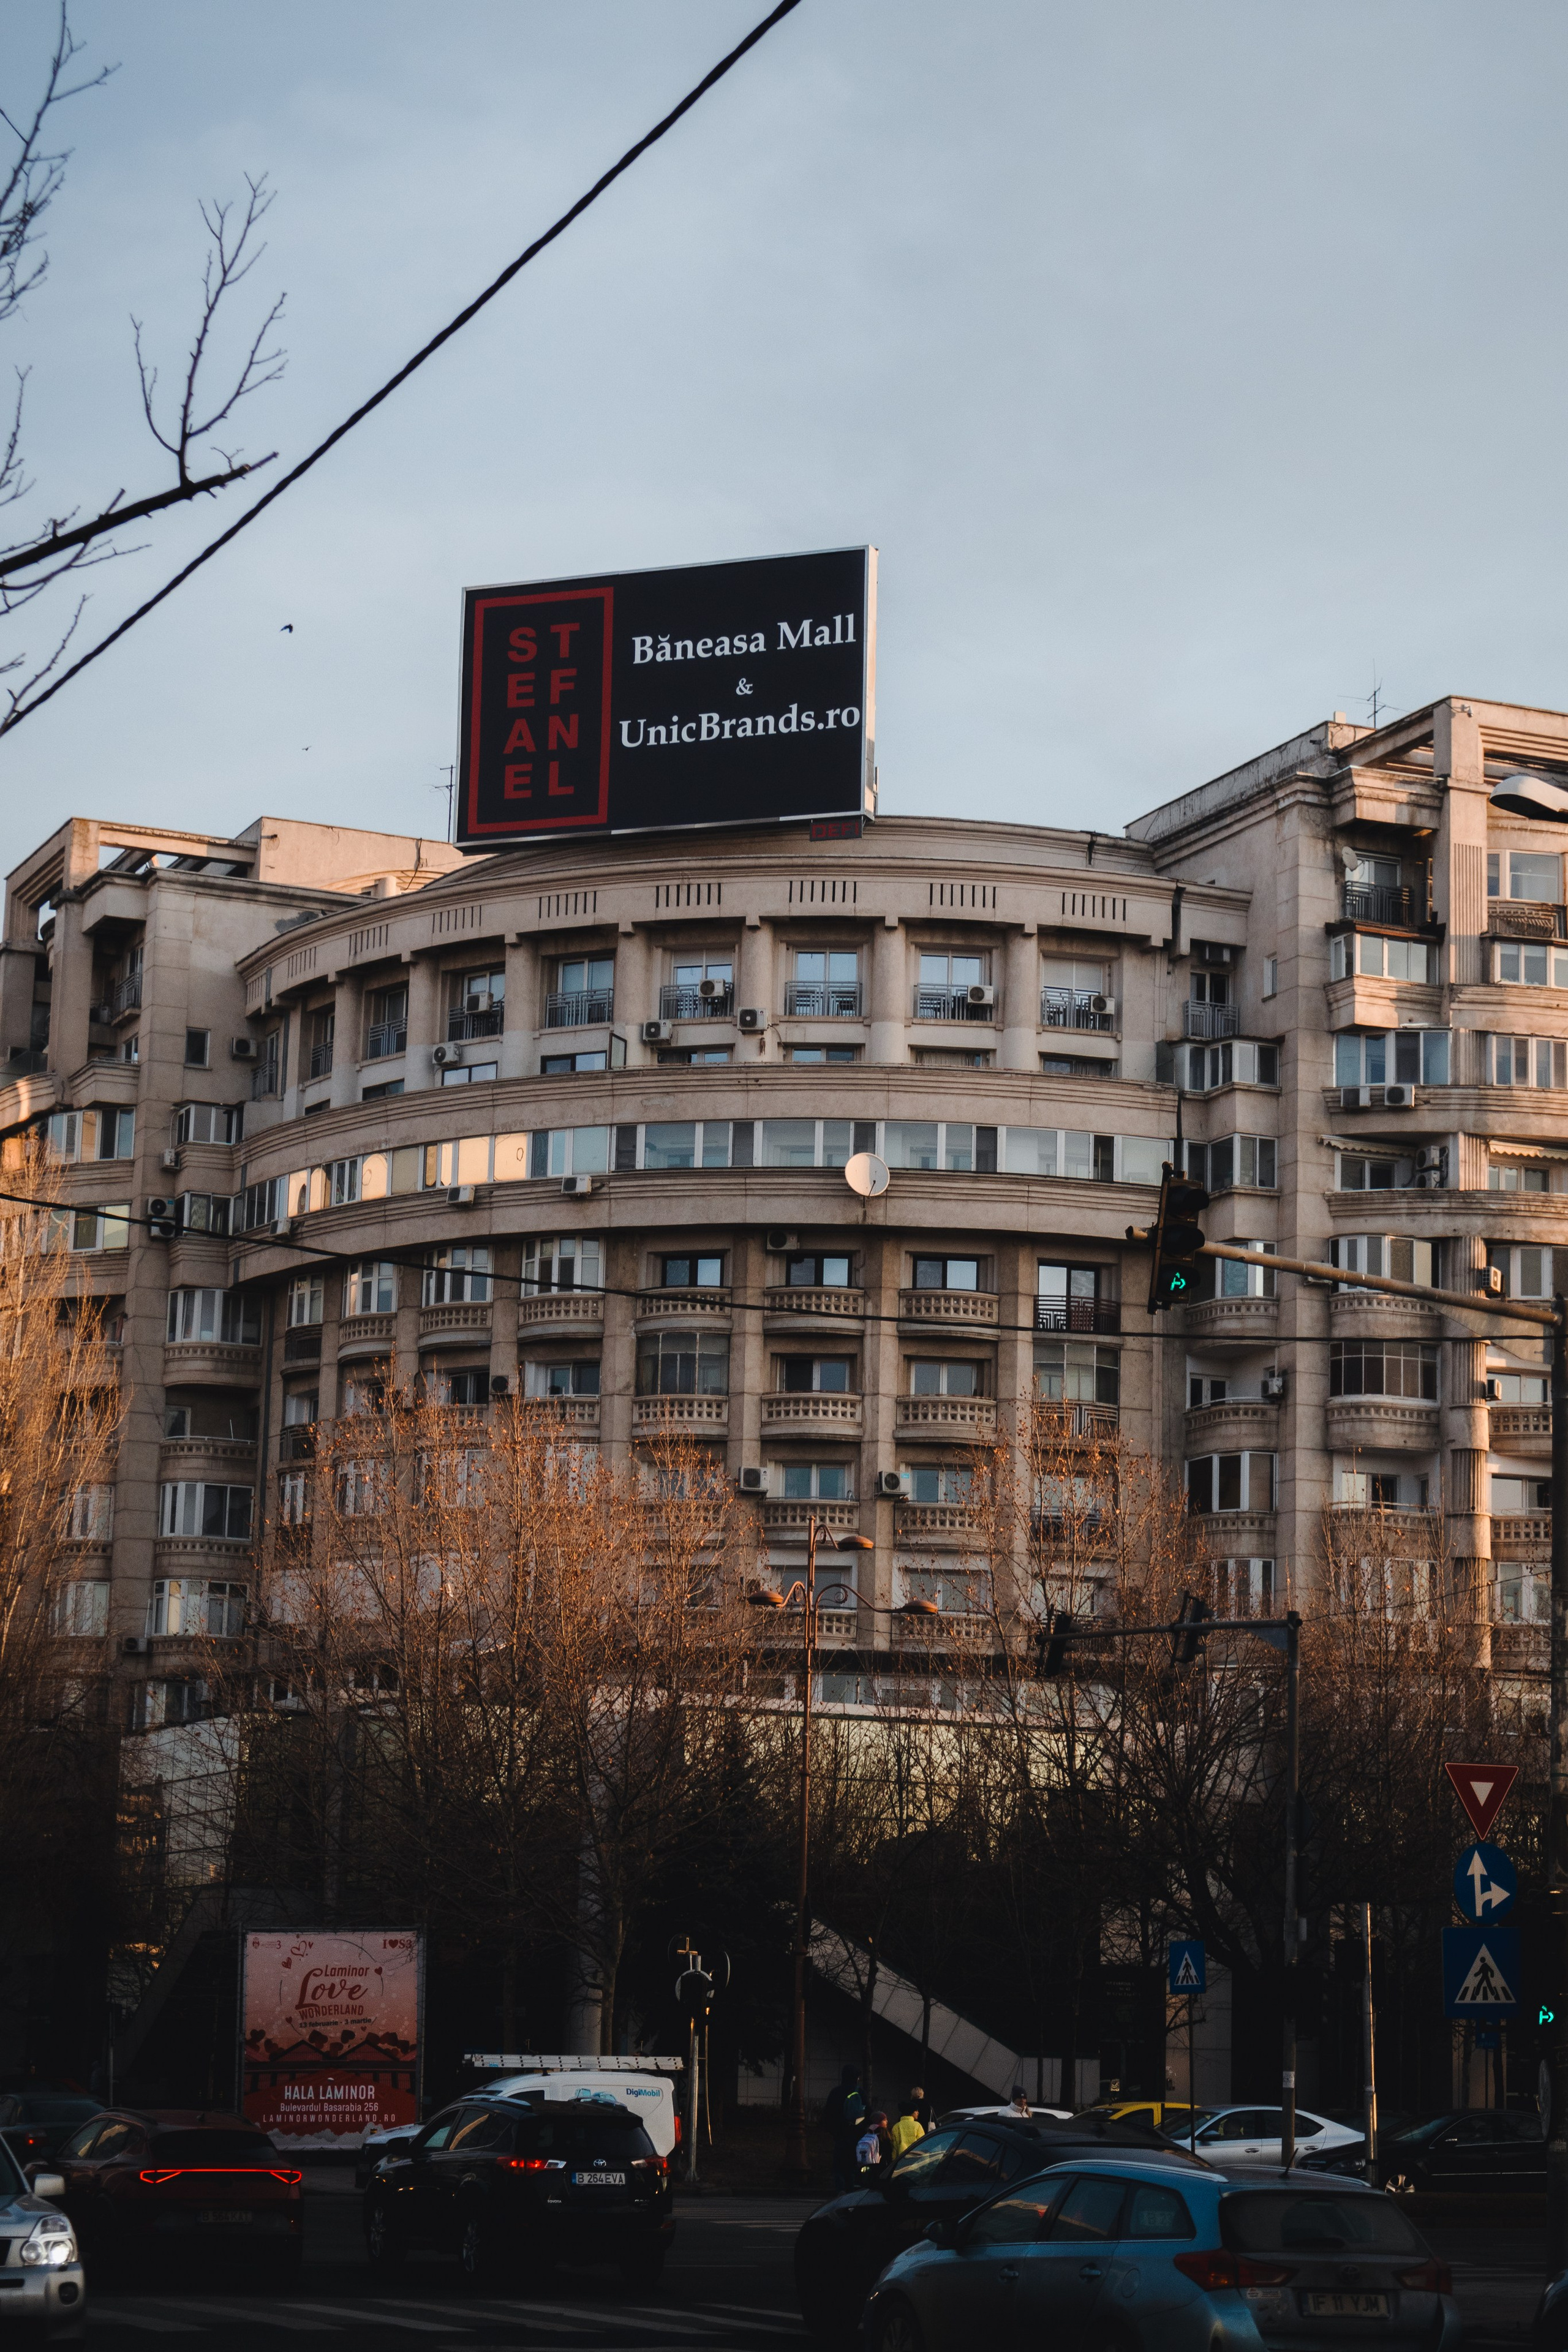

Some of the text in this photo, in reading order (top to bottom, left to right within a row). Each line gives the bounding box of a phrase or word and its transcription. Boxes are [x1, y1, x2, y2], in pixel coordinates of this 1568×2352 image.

[631, 613, 856, 664] Băneasa Mall
[736, 677, 753, 695] &
[619, 703, 860, 748] UnicBrands.ro
[811, 821, 859, 839] DEFI
[324, 1964, 370, 1977] Laminor
[295, 1968, 368, 2010] Love
[299, 2004, 364, 2021] WONDERLAND
[284, 2085, 375, 2100] HALA LAMINOR
[626, 2088, 660, 2097] DigiMobil
[280, 2102, 379, 2112] Bulevardul Basarabia 256
[263, 2114, 396, 2122] LAMINORWONDERLAND.RO
[578, 2173, 584, 2183] B
